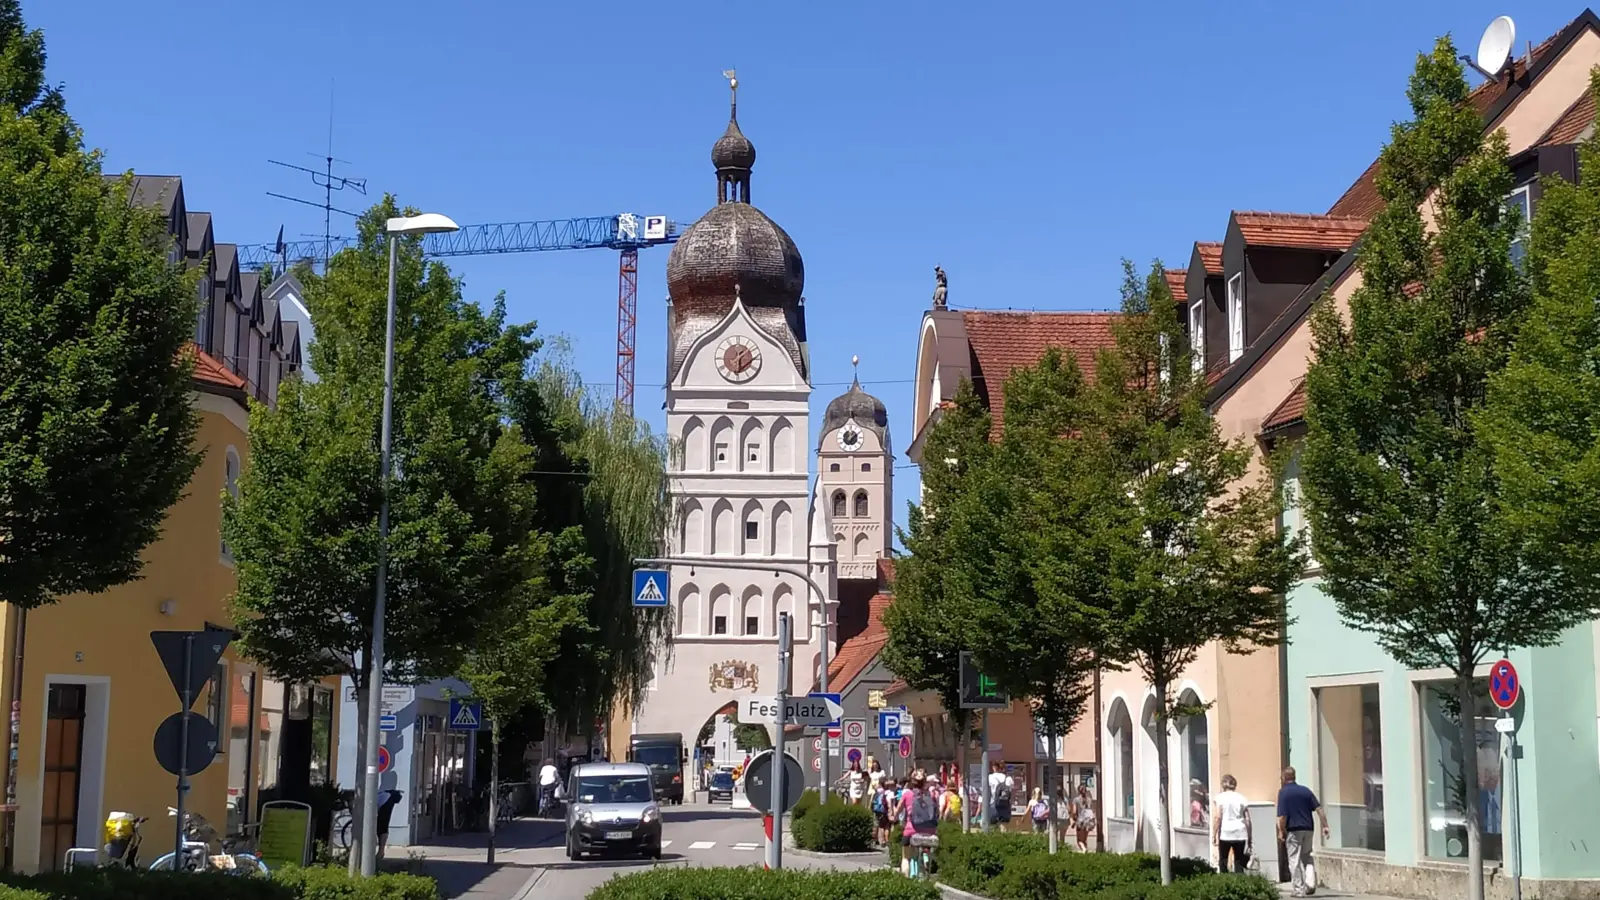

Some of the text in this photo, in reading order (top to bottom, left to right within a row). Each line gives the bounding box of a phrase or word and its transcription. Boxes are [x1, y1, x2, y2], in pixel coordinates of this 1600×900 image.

[648, 219, 661, 230] P
[749, 701, 825, 720] Fesplatz
[851, 726, 859, 734] 30
[885, 716, 899, 736] P
